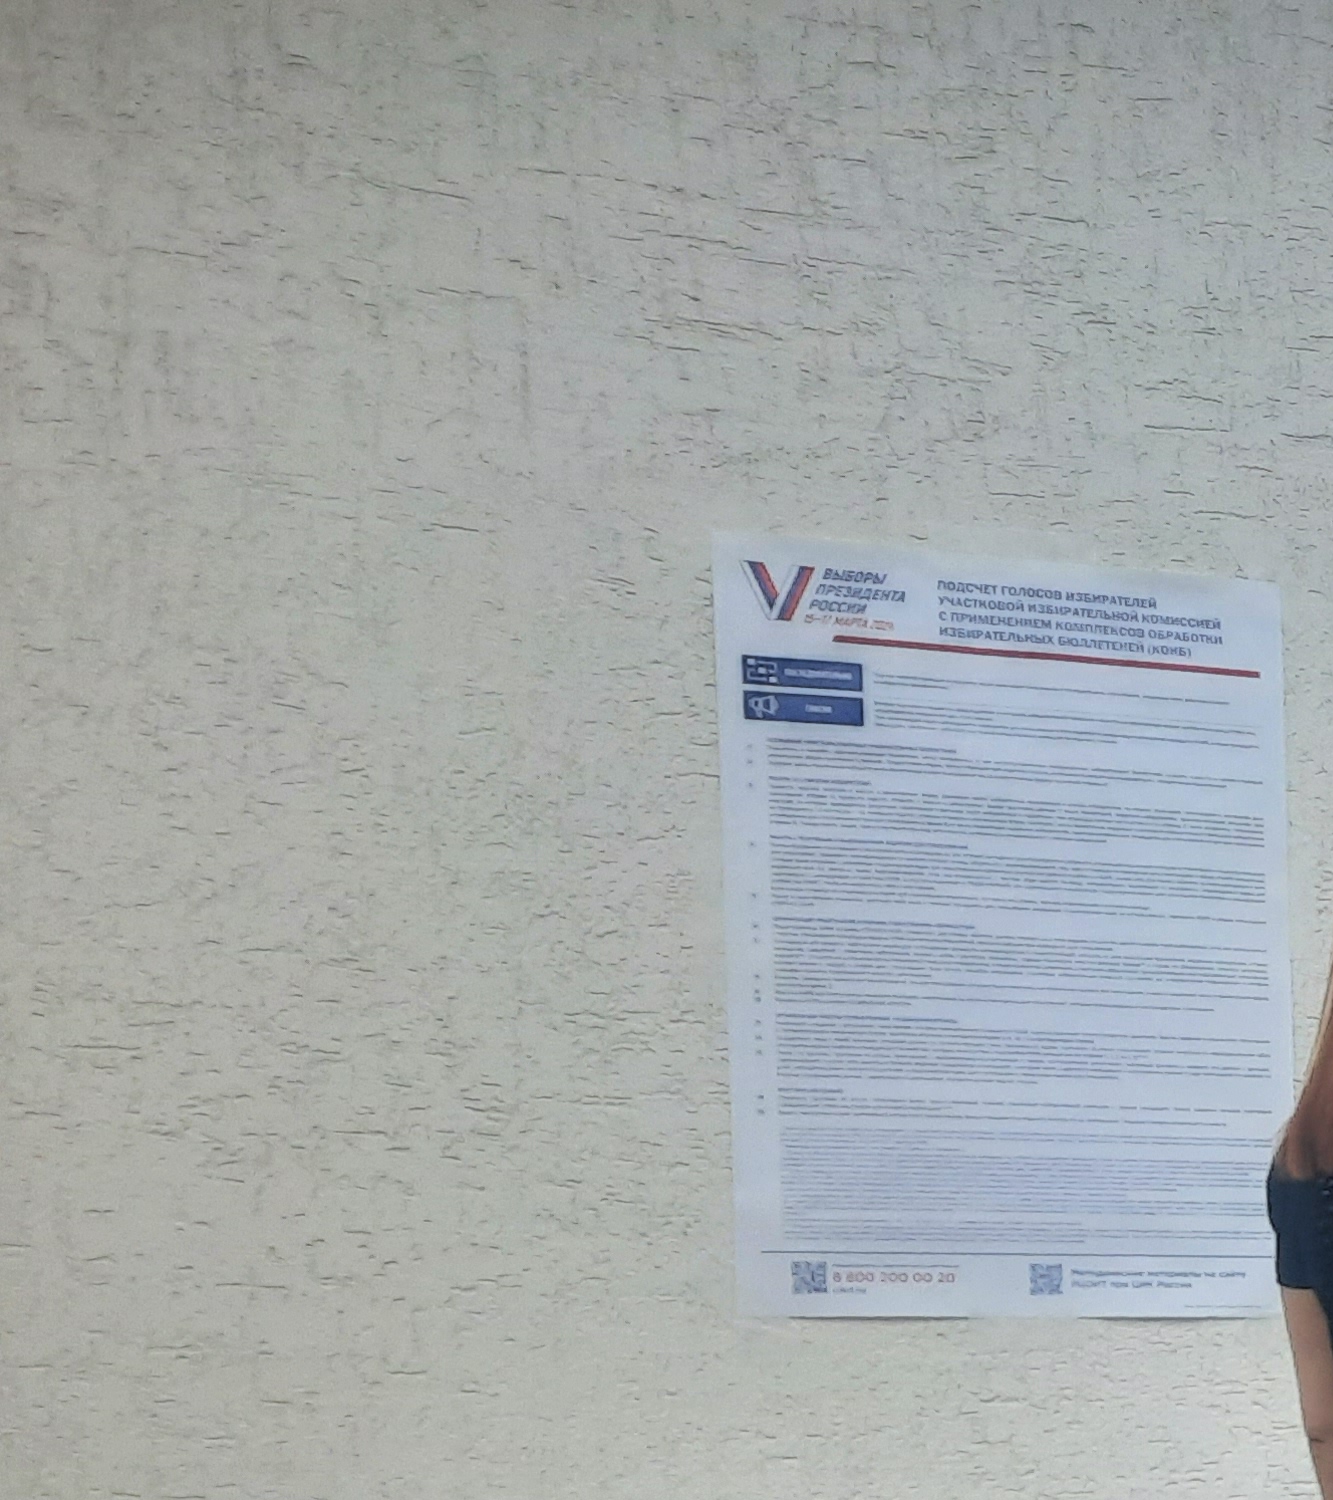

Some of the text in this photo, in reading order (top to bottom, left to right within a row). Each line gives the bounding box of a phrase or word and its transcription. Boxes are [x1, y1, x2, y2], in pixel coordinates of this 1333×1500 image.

[822, 568, 887, 584] ВЫБОРЫ
[809, 599, 867, 614] РОССИИ
[815, 584, 906, 603] ПРЕЗИДЕНТА
[937, 580, 1157, 609] ПОДСЧЕТ ГОЛОСОВ ИЗБИРАТЕЛЕЙ
[938, 595, 1222, 630] УЧАСТКОВОЙ ИЗБИРАТЕЛЬНОЙ КОМИССИЕЙ
[938, 611, 1223, 645] С ПРИМЕНЕНИЕМ КОМПЛЕКСОВ ОБРАБОТКИ
[939, 626, 1056, 645] ИЗБИРАТЕЛЬНЫХ
[1058, 636, 1144, 653] БЮЛЛЕТЕНЕЙ
